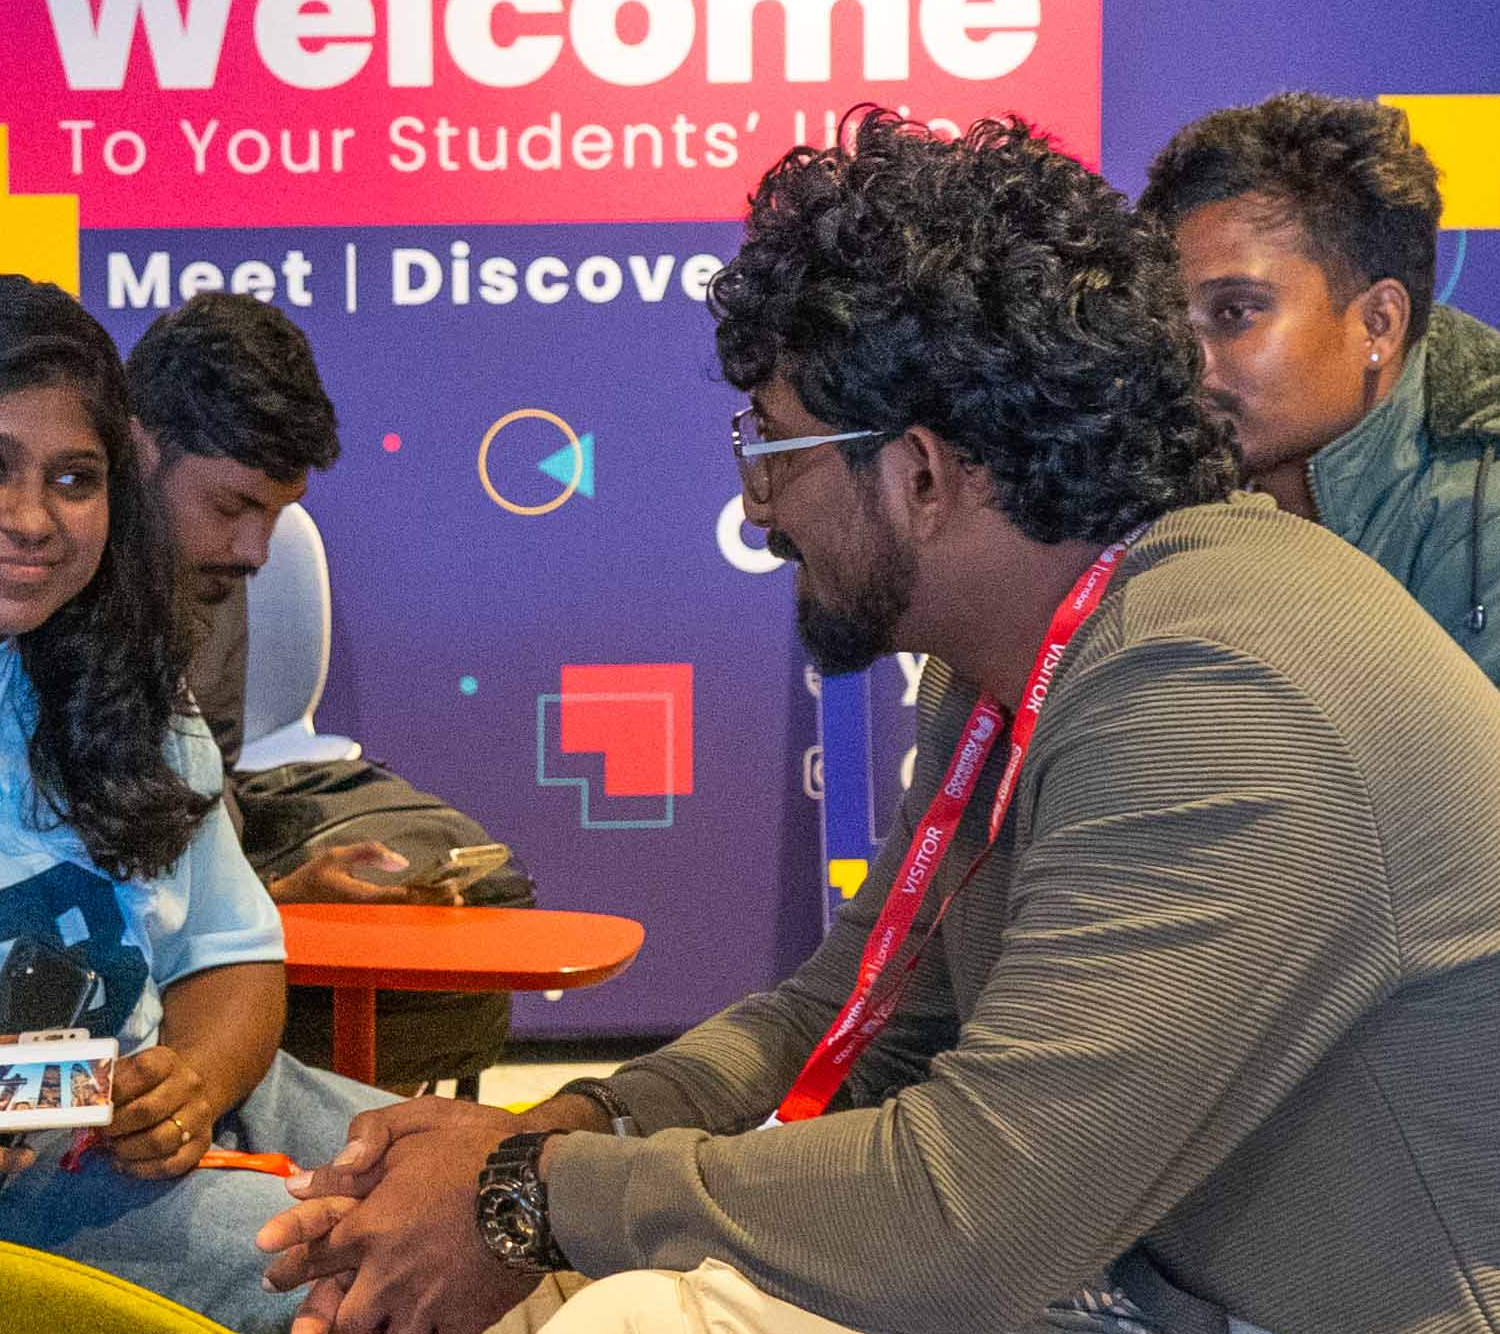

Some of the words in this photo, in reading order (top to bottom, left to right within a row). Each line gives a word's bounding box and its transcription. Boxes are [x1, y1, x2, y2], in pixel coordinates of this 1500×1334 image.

[59, 120, 147, 176] To
[180, 118, 355, 175] Your
[388, 111, 760, 172] Students'
[107, 250, 312, 309] Meet
[393, 241, 724, 309] Discove
[1073, 570, 1102, 611] London
[1026, 642, 1065, 714] VISITOR
[944, 738, 976, 797] Coventry
[902, 825, 944, 895] VISITOR
